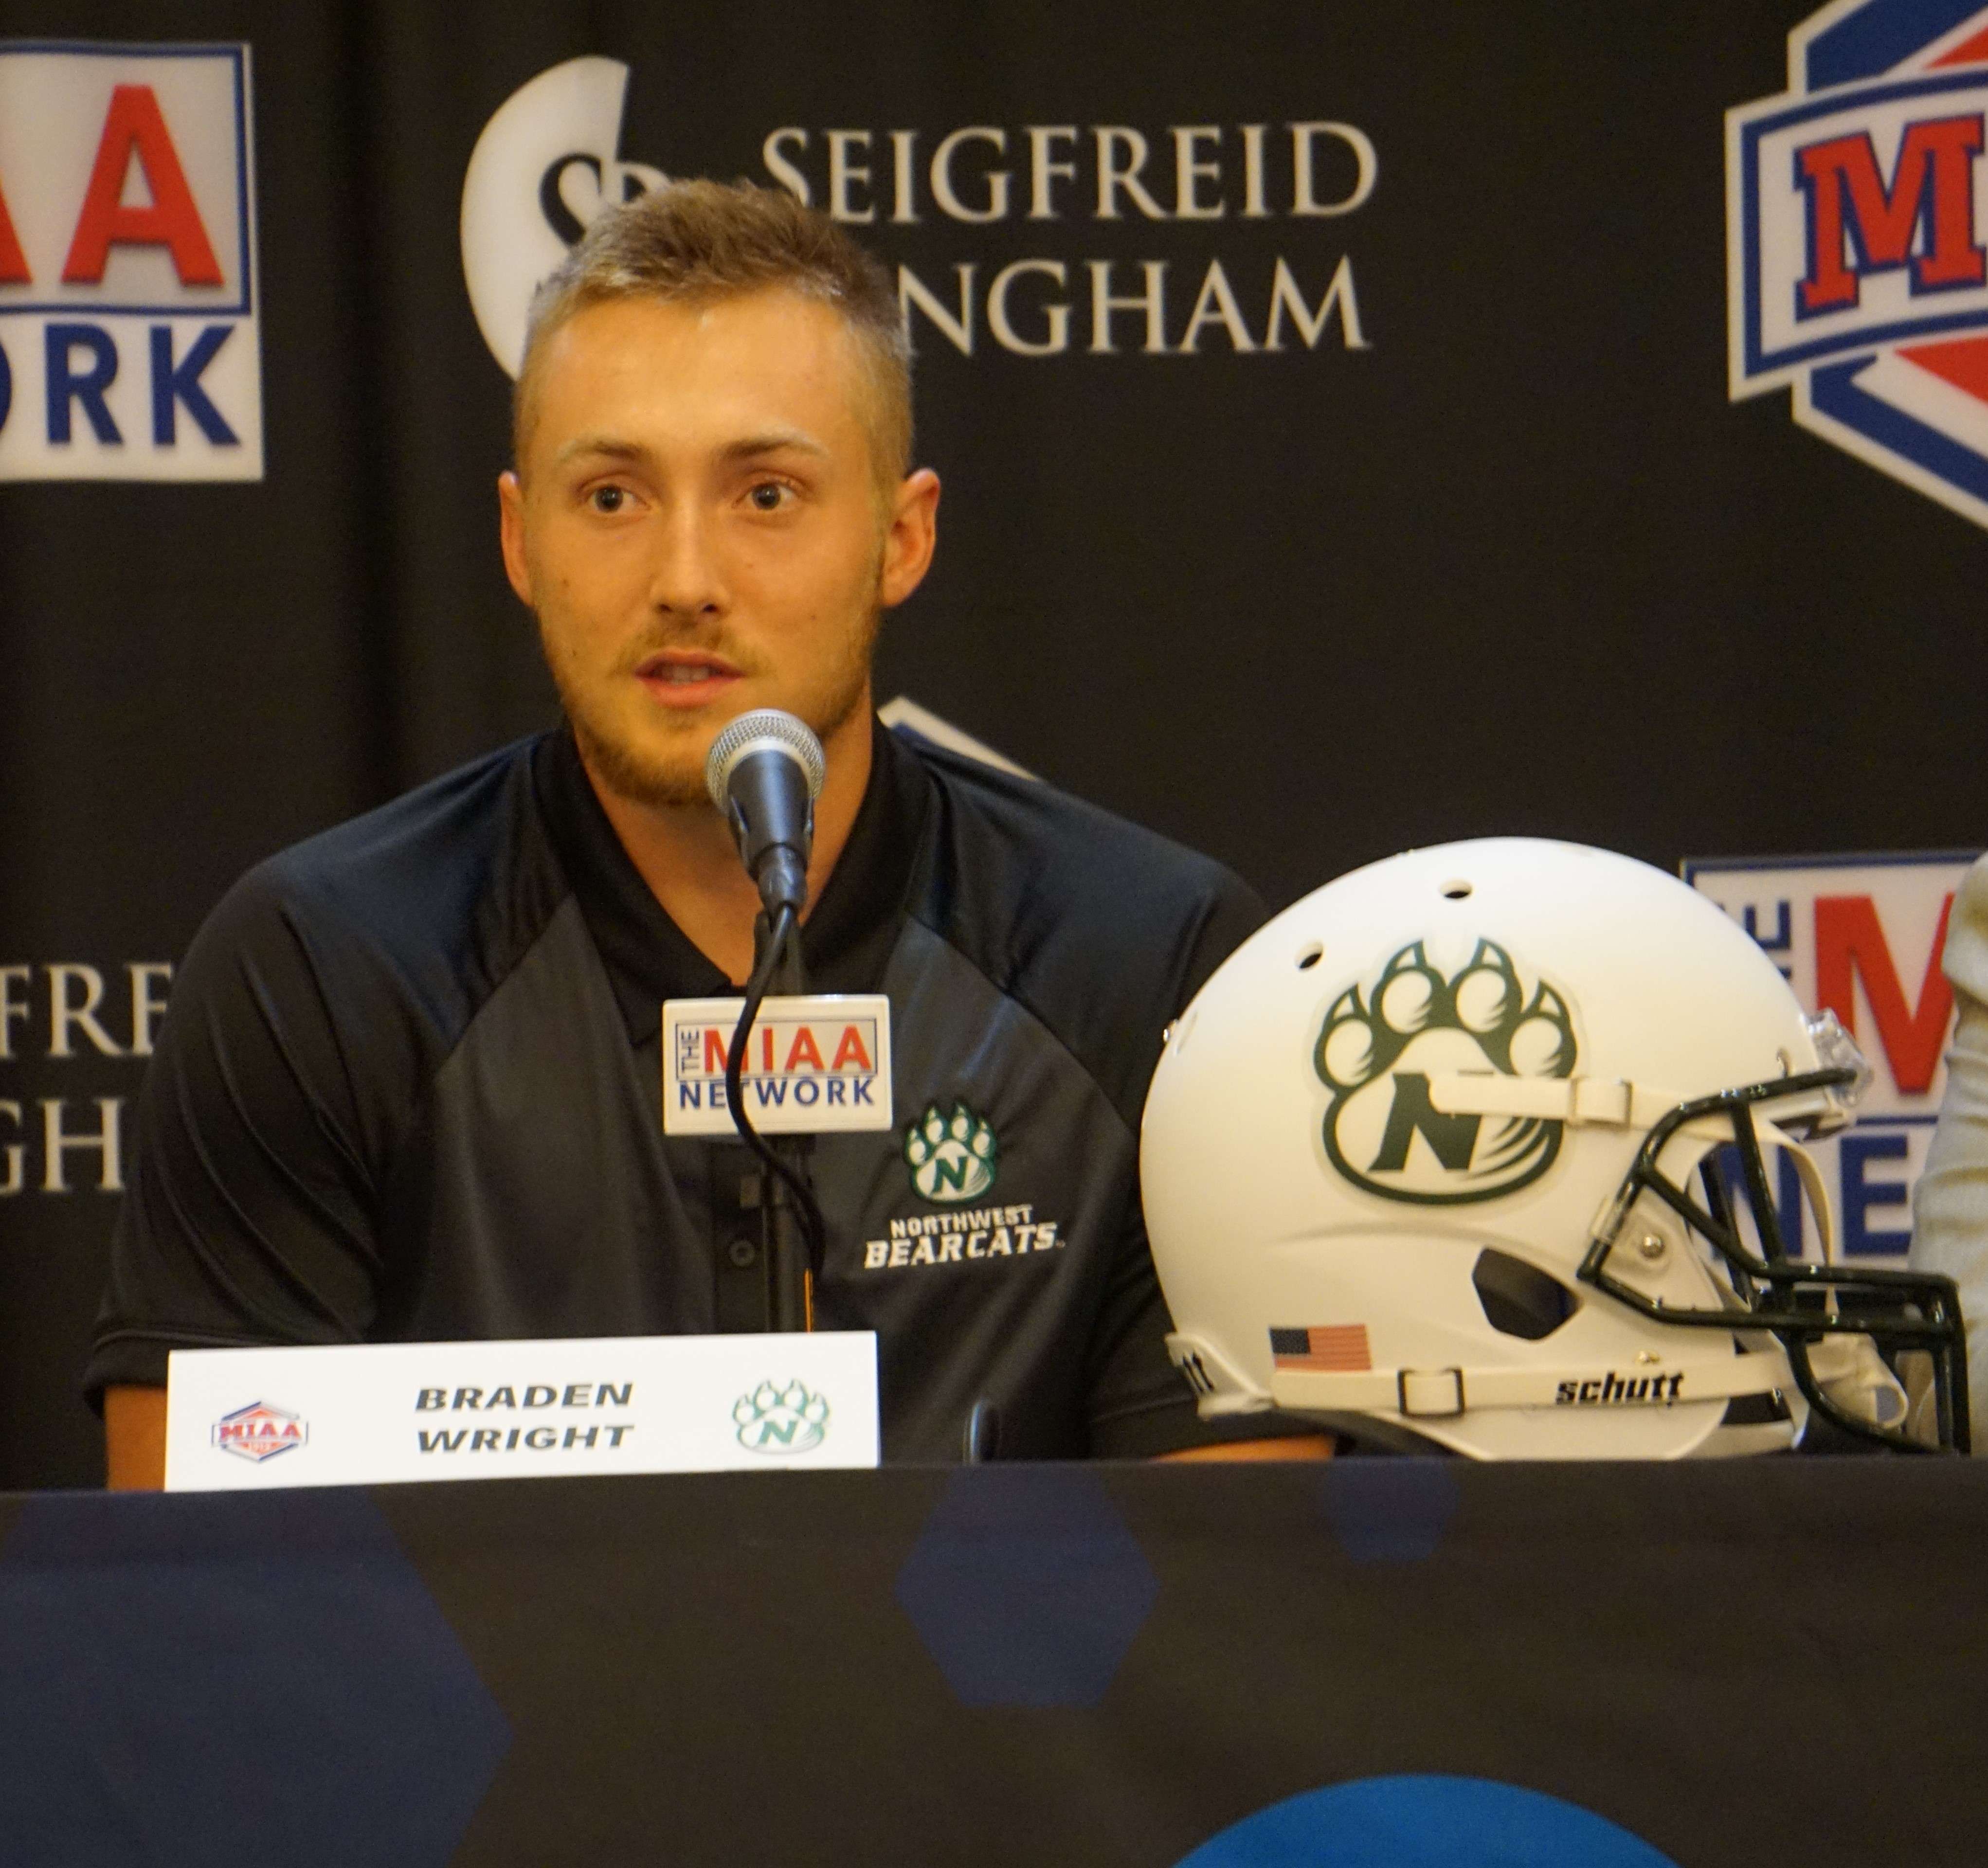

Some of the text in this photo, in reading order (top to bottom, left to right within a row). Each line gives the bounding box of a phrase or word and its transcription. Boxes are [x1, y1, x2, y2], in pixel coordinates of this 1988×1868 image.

[0, 85, 225, 286] A
[762, 121, 1377, 224] SEIGFREID
[1793, 112, 1986, 323] M
[0, 323, 241, 447] RK
[681, 1029, 700, 1073] THE
[705, 1024, 872, 1074] MIAA
[929, 1154, 970, 1195] N
[890, 1204, 1032, 1239] NORTHWEST
[864, 1222, 1057, 1269] BEARCATS
[416, 1383, 633, 1411] BRADEN
[1556, 1371, 1684, 1403] schutt
[220, 1421, 301, 1441] MIAA
[417, 1425, 634, 1453] WRIGHT
[758, 1419, 798, 1445] N
